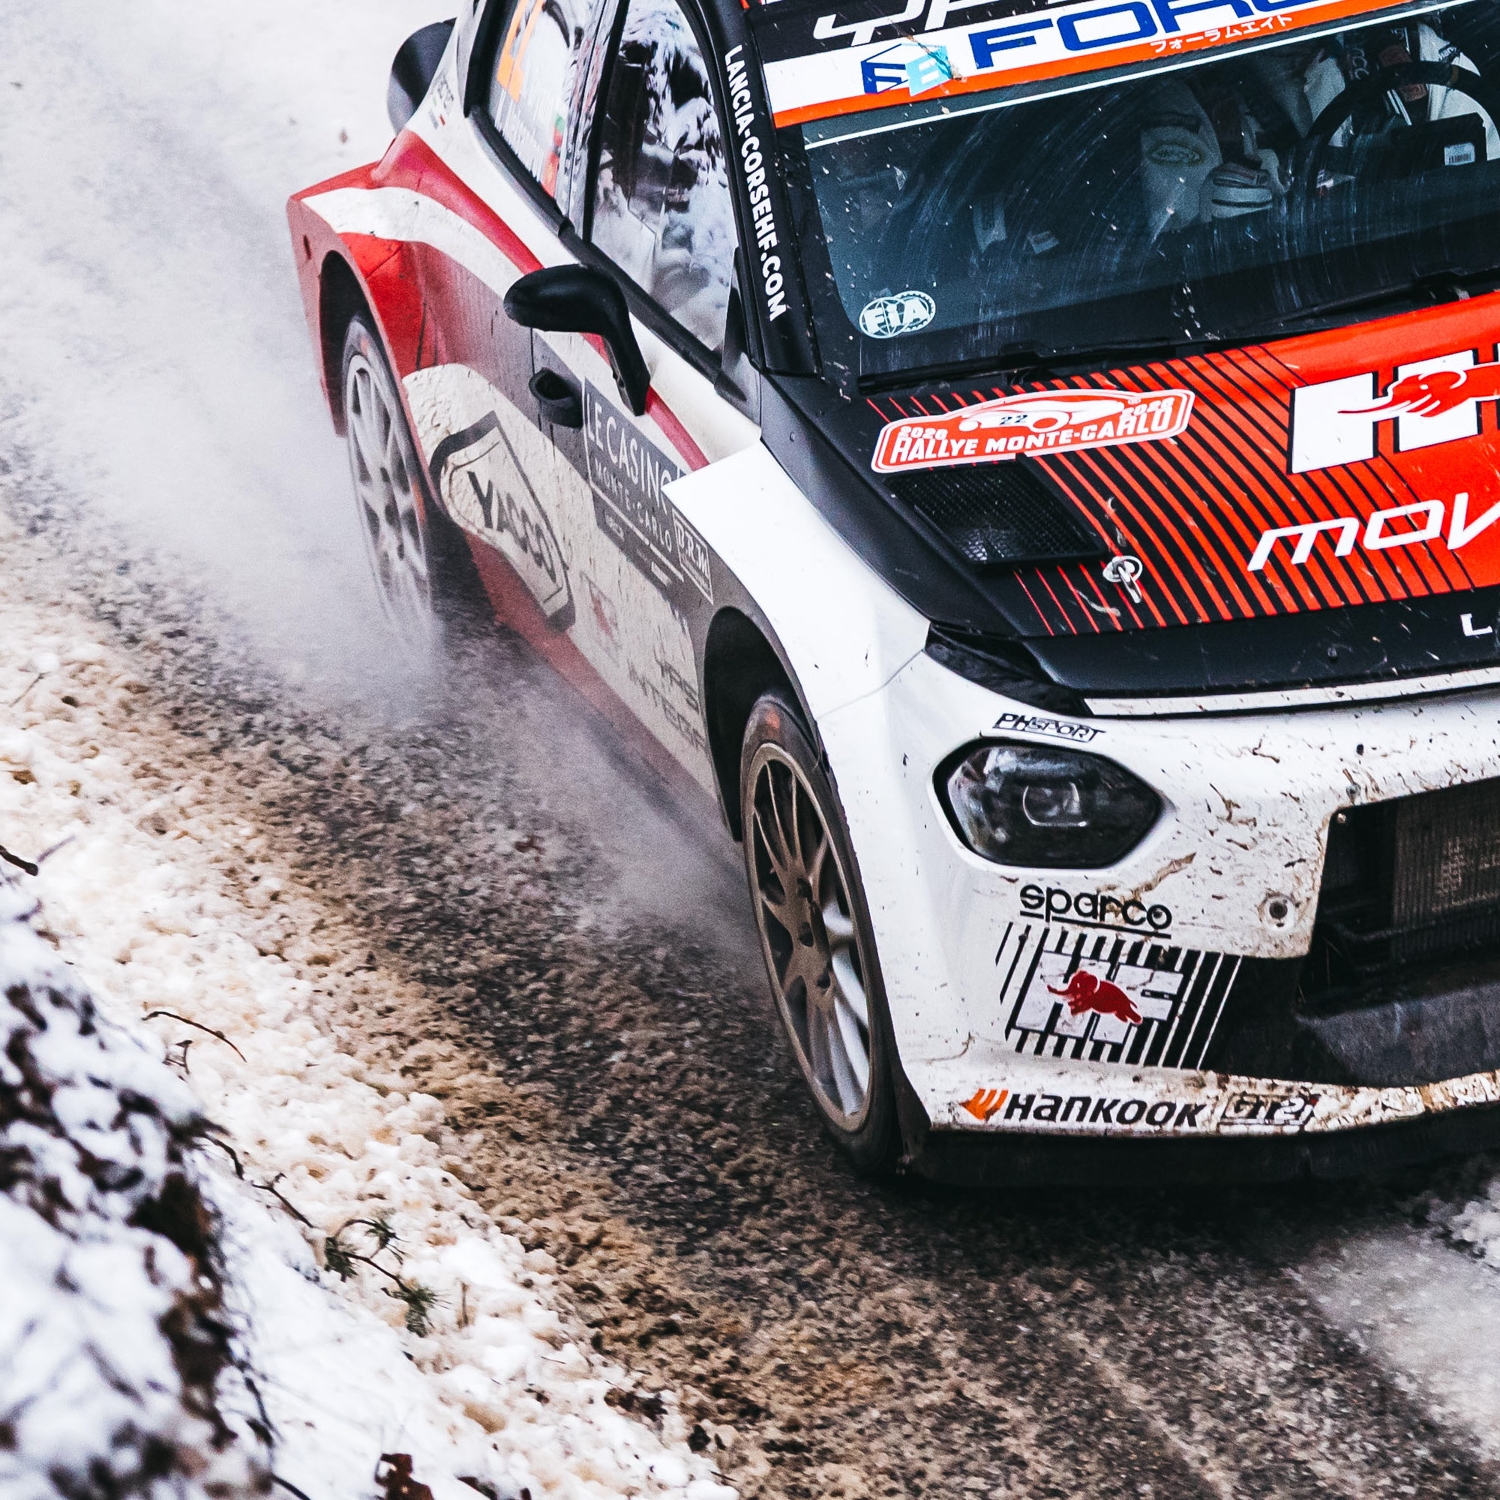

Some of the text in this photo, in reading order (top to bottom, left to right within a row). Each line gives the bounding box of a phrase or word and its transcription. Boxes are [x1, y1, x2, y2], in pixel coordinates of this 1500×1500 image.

[1150, 14, 1293, 54] フォーラムエイト
[724, 44, 787, 322] LANCIA-CORSEHF.COM
[586, 392, 604, 451] LE
[889, 407, 1173, 464] RALLYE MONTE-CARLO
[1019, 883, 1173, 931] sparco
